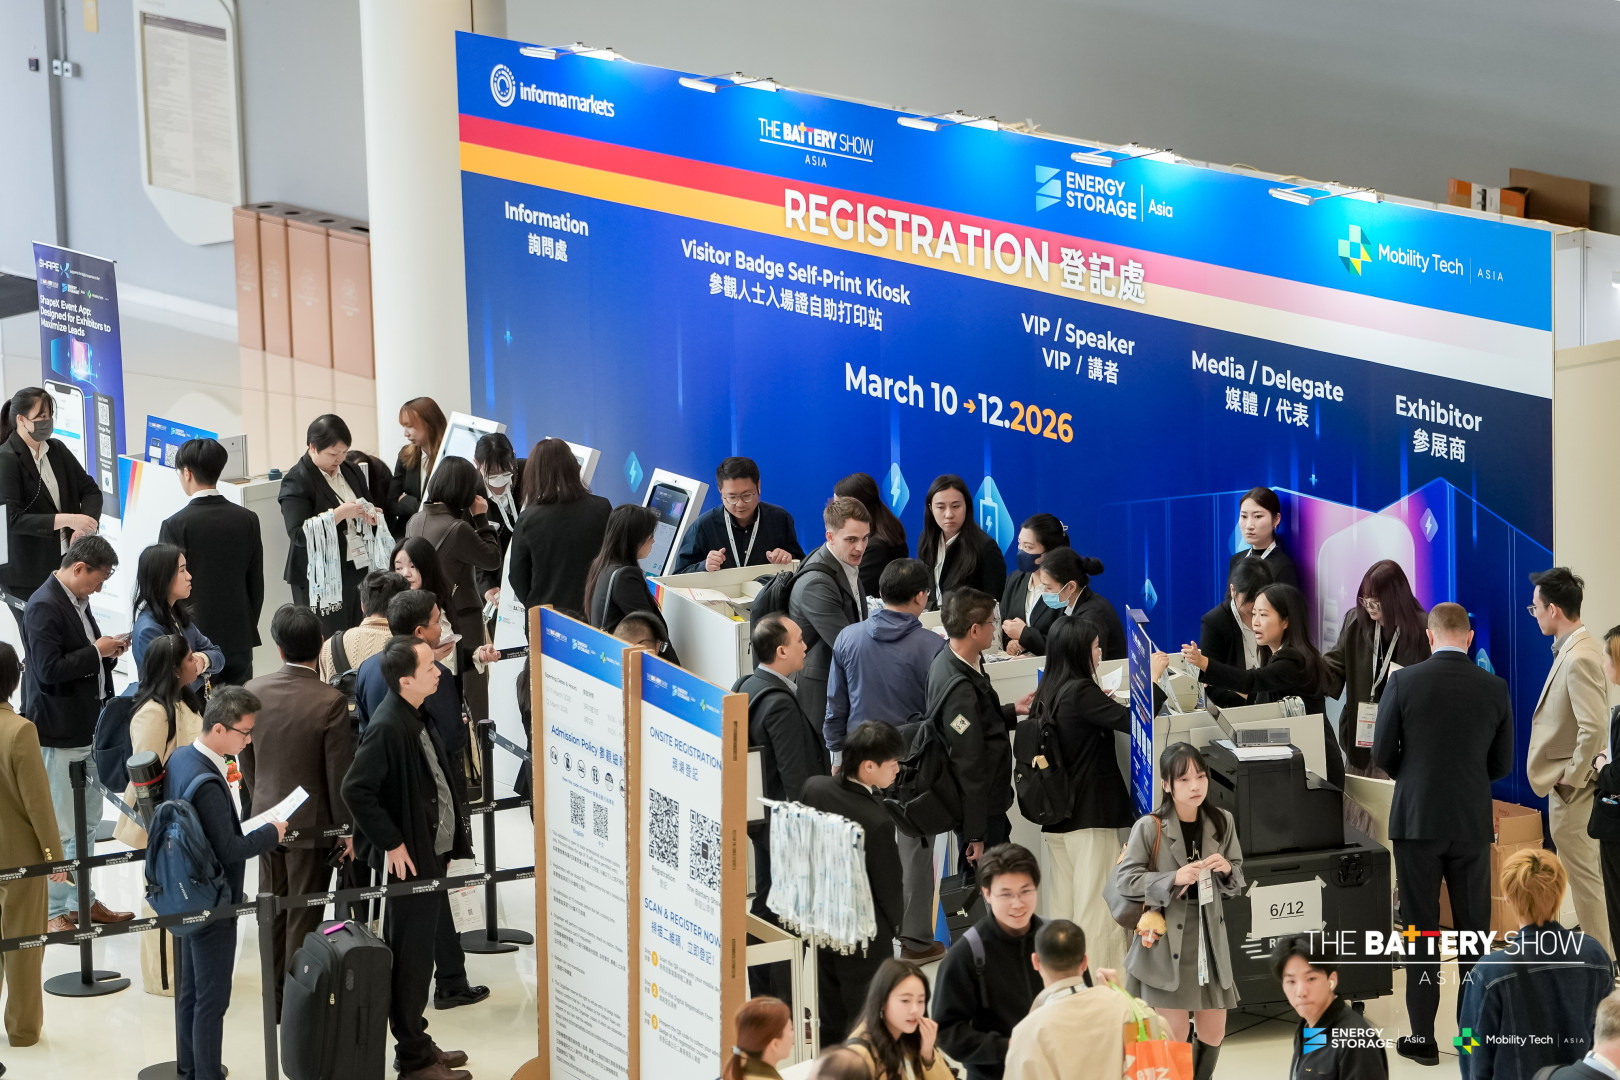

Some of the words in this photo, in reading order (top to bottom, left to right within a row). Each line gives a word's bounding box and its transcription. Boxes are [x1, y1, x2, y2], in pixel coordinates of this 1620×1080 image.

[758, 118, 781, 140] THE
[783, 122, 837, 150] BATTERY
[839, 134, 874, 157] SHOW
[805, 154, 827, 168] ASIA
[1066, 171, 1126, 198] ENERGY
[504, 200, 590, 236] Information
[1066, 190, 1137, 220] STORAGE
[1148, 198, 1174, 218] Asia
[528, 232, 568, 263] 詢問處
[784, 188, 1049, 283] REGISTRATION
[1059, 246, 1146, 304] 登記處
[1378, 243, 1430, 274] Mobility
[1432, 254, 1464, 276] Tech
[1477, 267, 1504, 282] ASIA
[681, 238, 731, 266] Visitor
[736, 250, 784, 280] Badge
[788, 262, 862, 295] Self-Print
[866, 278, 911, 306] Kiosk
[40, 294, 60, 310] ShapeX
[60, 300, 78, 312] Event
[40, 306, 66, 322] Designed
[67, 312, 76, 323] for
[76, 316, 104, 331] Exhibitors
[104, 324, 112, 332] to
[708, 272, 883, 332] 參觀人士入場證自助打印站
[40, 317, 67, 332] Maximize
[68, 324, 86, 336] Leads
[1020, 312, 1050, 336] VIP
[1064, 322, 1136, 356] Speaker
[1042, 347, 1071, 371] VIP
[1087, 356, 1120, 385] 講者
[1191, 350, 1245, 381] Media
[1261, 365, 1344, 402] Delegate
[845, 362, 924, 408] March
[930, 381, 958, 416] 10
[1225, 386, 1258, 417] 媒體
[1276, 397, 1310, 428] 代表
[1395, 394, 1482, 432] Exhibitor
[1412, 428, 1466, 463] 參展商
[551, 724, 580, 746] Admission
[581, 738, 598, 756] Policy
[650, 726, 673, 747] ONSITE
[674, 738, 722, 771] REGISTRATION
[644, 897, 662, 916] SCAN
[664, 908, 668, 920] &
[670, 912, 702, 938] REGISTER
[1270, 900, 1304, 917] 6/12
